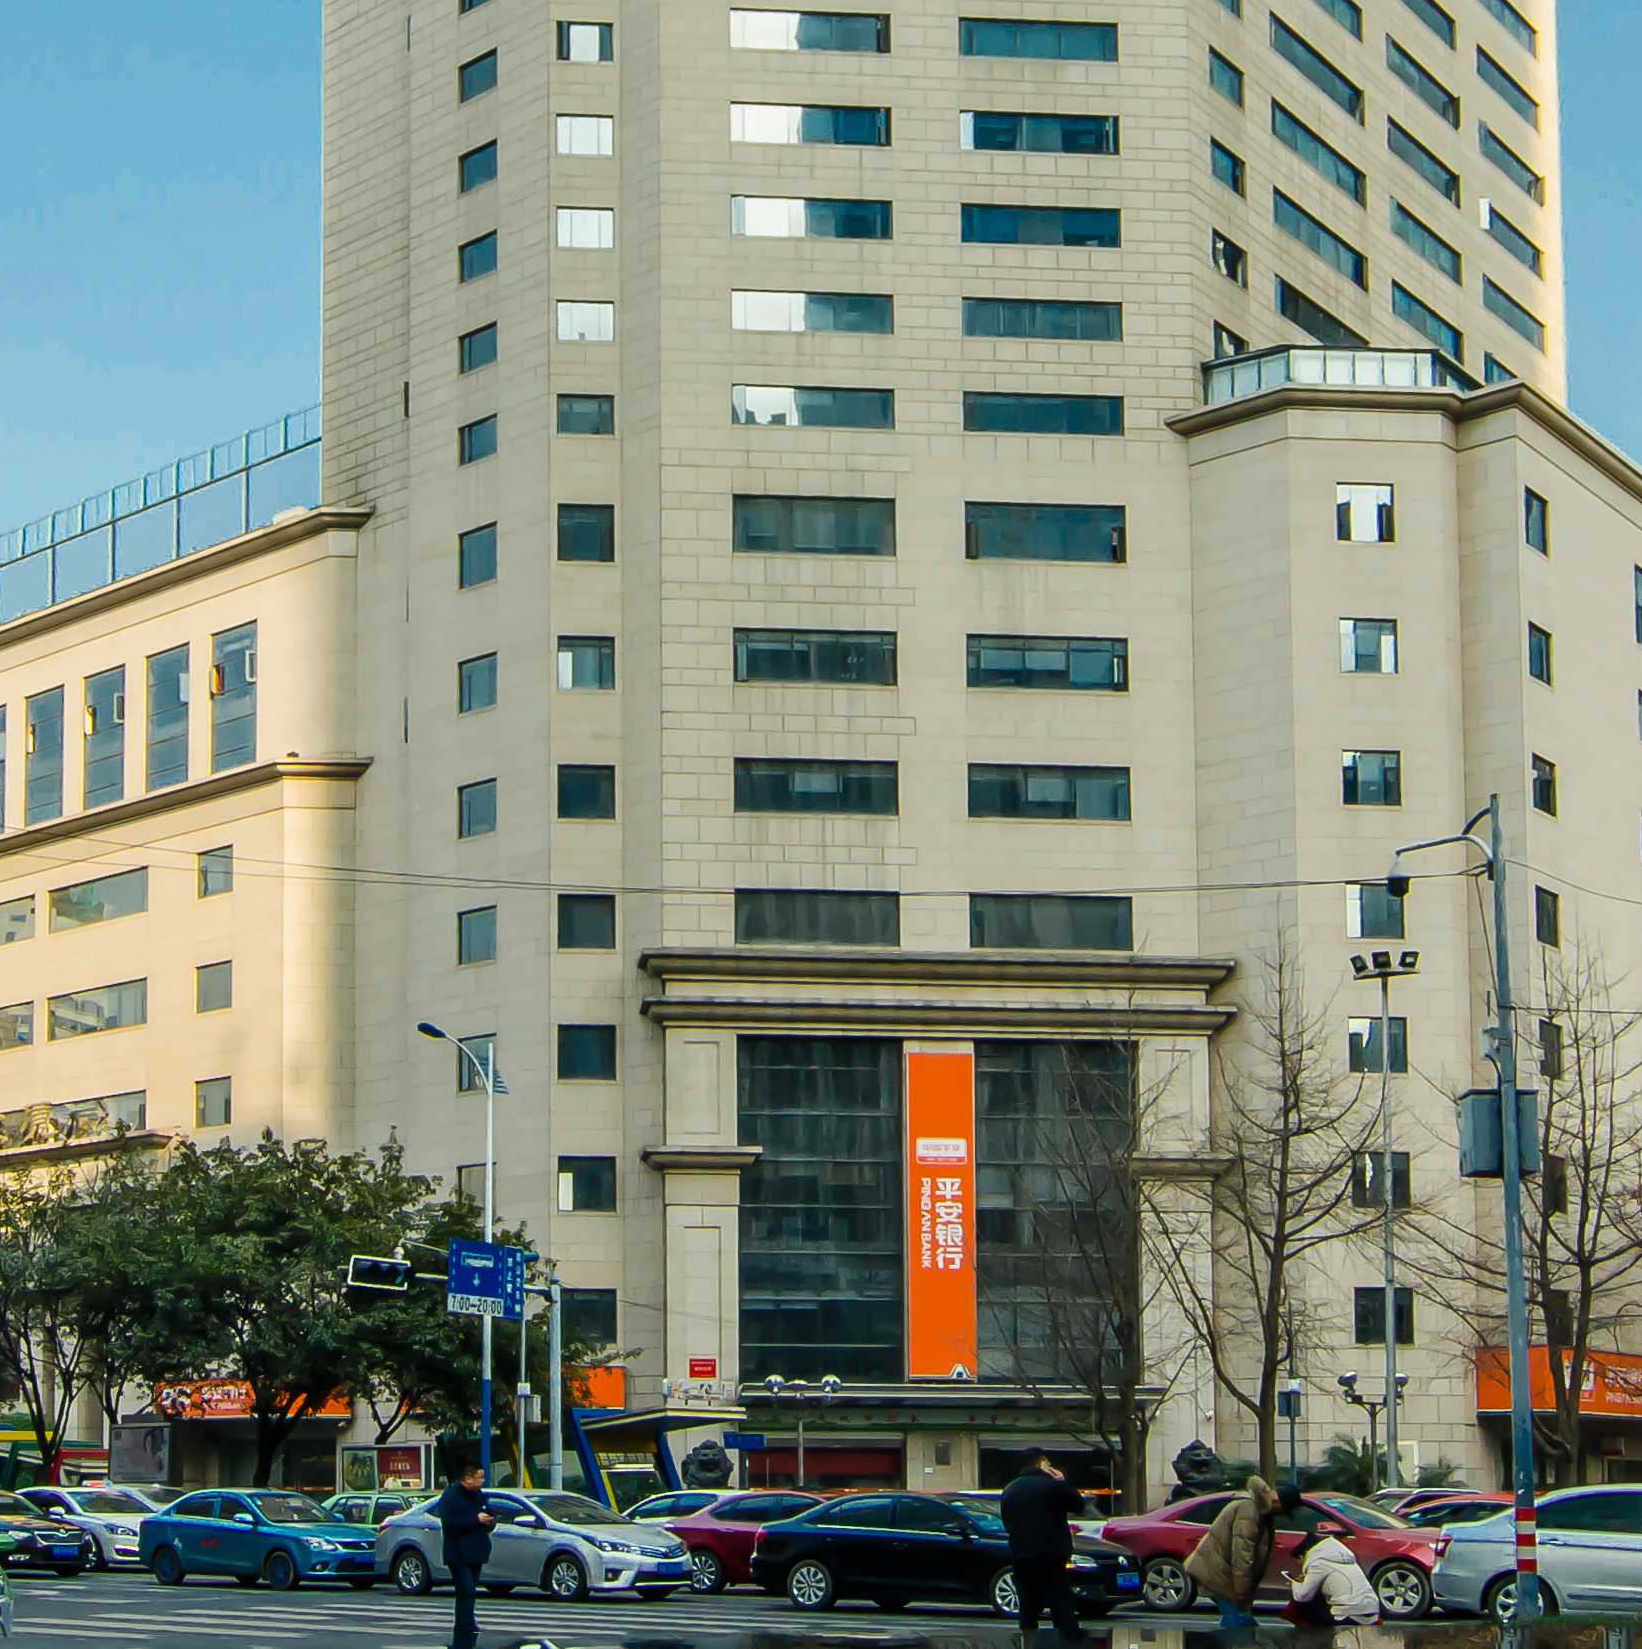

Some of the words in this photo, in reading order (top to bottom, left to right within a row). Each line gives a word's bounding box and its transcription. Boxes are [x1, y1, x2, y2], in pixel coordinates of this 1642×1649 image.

[920, 1233, 932, 1269] BANK
[934, 1177, 964, 1271] 平安银行
